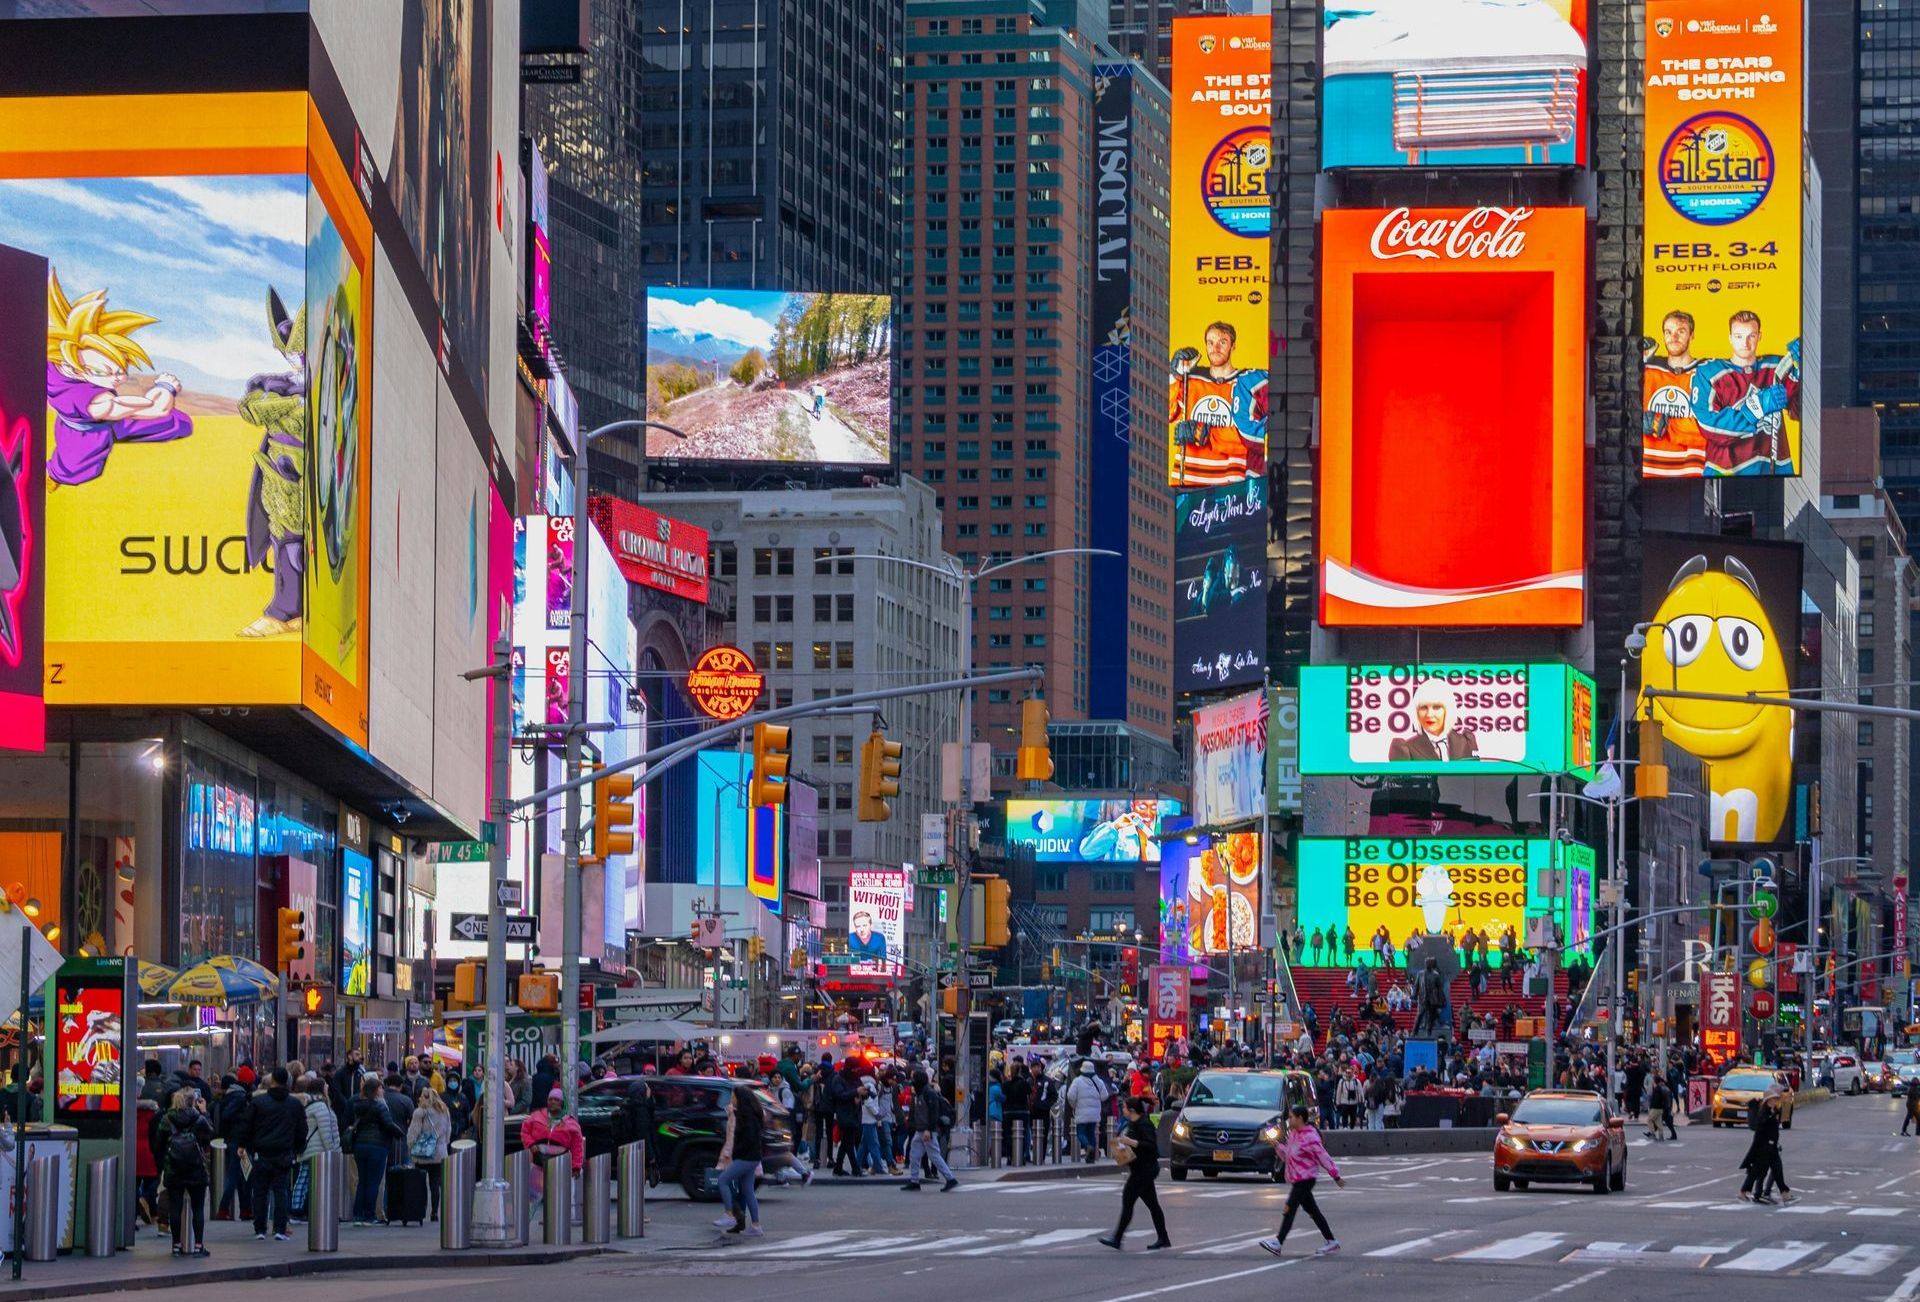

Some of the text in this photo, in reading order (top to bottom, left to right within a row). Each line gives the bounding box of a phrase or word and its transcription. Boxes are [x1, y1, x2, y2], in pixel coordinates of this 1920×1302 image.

[1660, 56, 1773, 71] THE STARS
[1204, 75, 1242, 87] THE
[1648, 71, 1785, 86] ARE HEADING
[1191, 90, 1231, 102] ARE
[1677, 87, 1755, 101] SOUTH!
[1700, 198, 1743, 207] HONDA
[1653, 240, 1779, 261] FEB. 3-4
[1197, 255, 1261, 272] FEB.
[1655, 262, 1777, 273] SOUTH FLORIDA
[1198, 275, 1250, 285] SOUTH
[1676, 283, 1701, 291] ESPN
[1217, 294, 1243, 302] ESPN
[619, 530, 706, 578] CROWNE PLAZA
[709, 653, 741, 668] HOT
[1346, 664, 1381, 686] Be
[691, 687, 759, 696] ORIGINAL GLAZED
[1346, 686, 1529, 710] Be Oessed
[708, 697, 742, 714] NOW
[1346, 709, 1529, 733] Be Oessed
[441, 847, 453, 862] W
[457, 846, 472, 861] 45
[1344, 839, 1529, 861] Be Obsessed
[920, 872, 928, 882] W
[932, 871, 944, 882] 45
[1344, 863, 1380, 884] Be
[853, 889, 901, 908] WITHOUT
[1344, 886, 1380, 907] Be
[879, 907, 900, 921] YOU
[464, 920, 488, 934] ONE
[96, 958, 123, 967] LinkNYC
[1680, 939, 1714, 984] R
[171, 992, 223, 1004] SABRETT
[1710, 976, 1736, 1026] tkts
[1757, 1000, 1769, 1012] m
